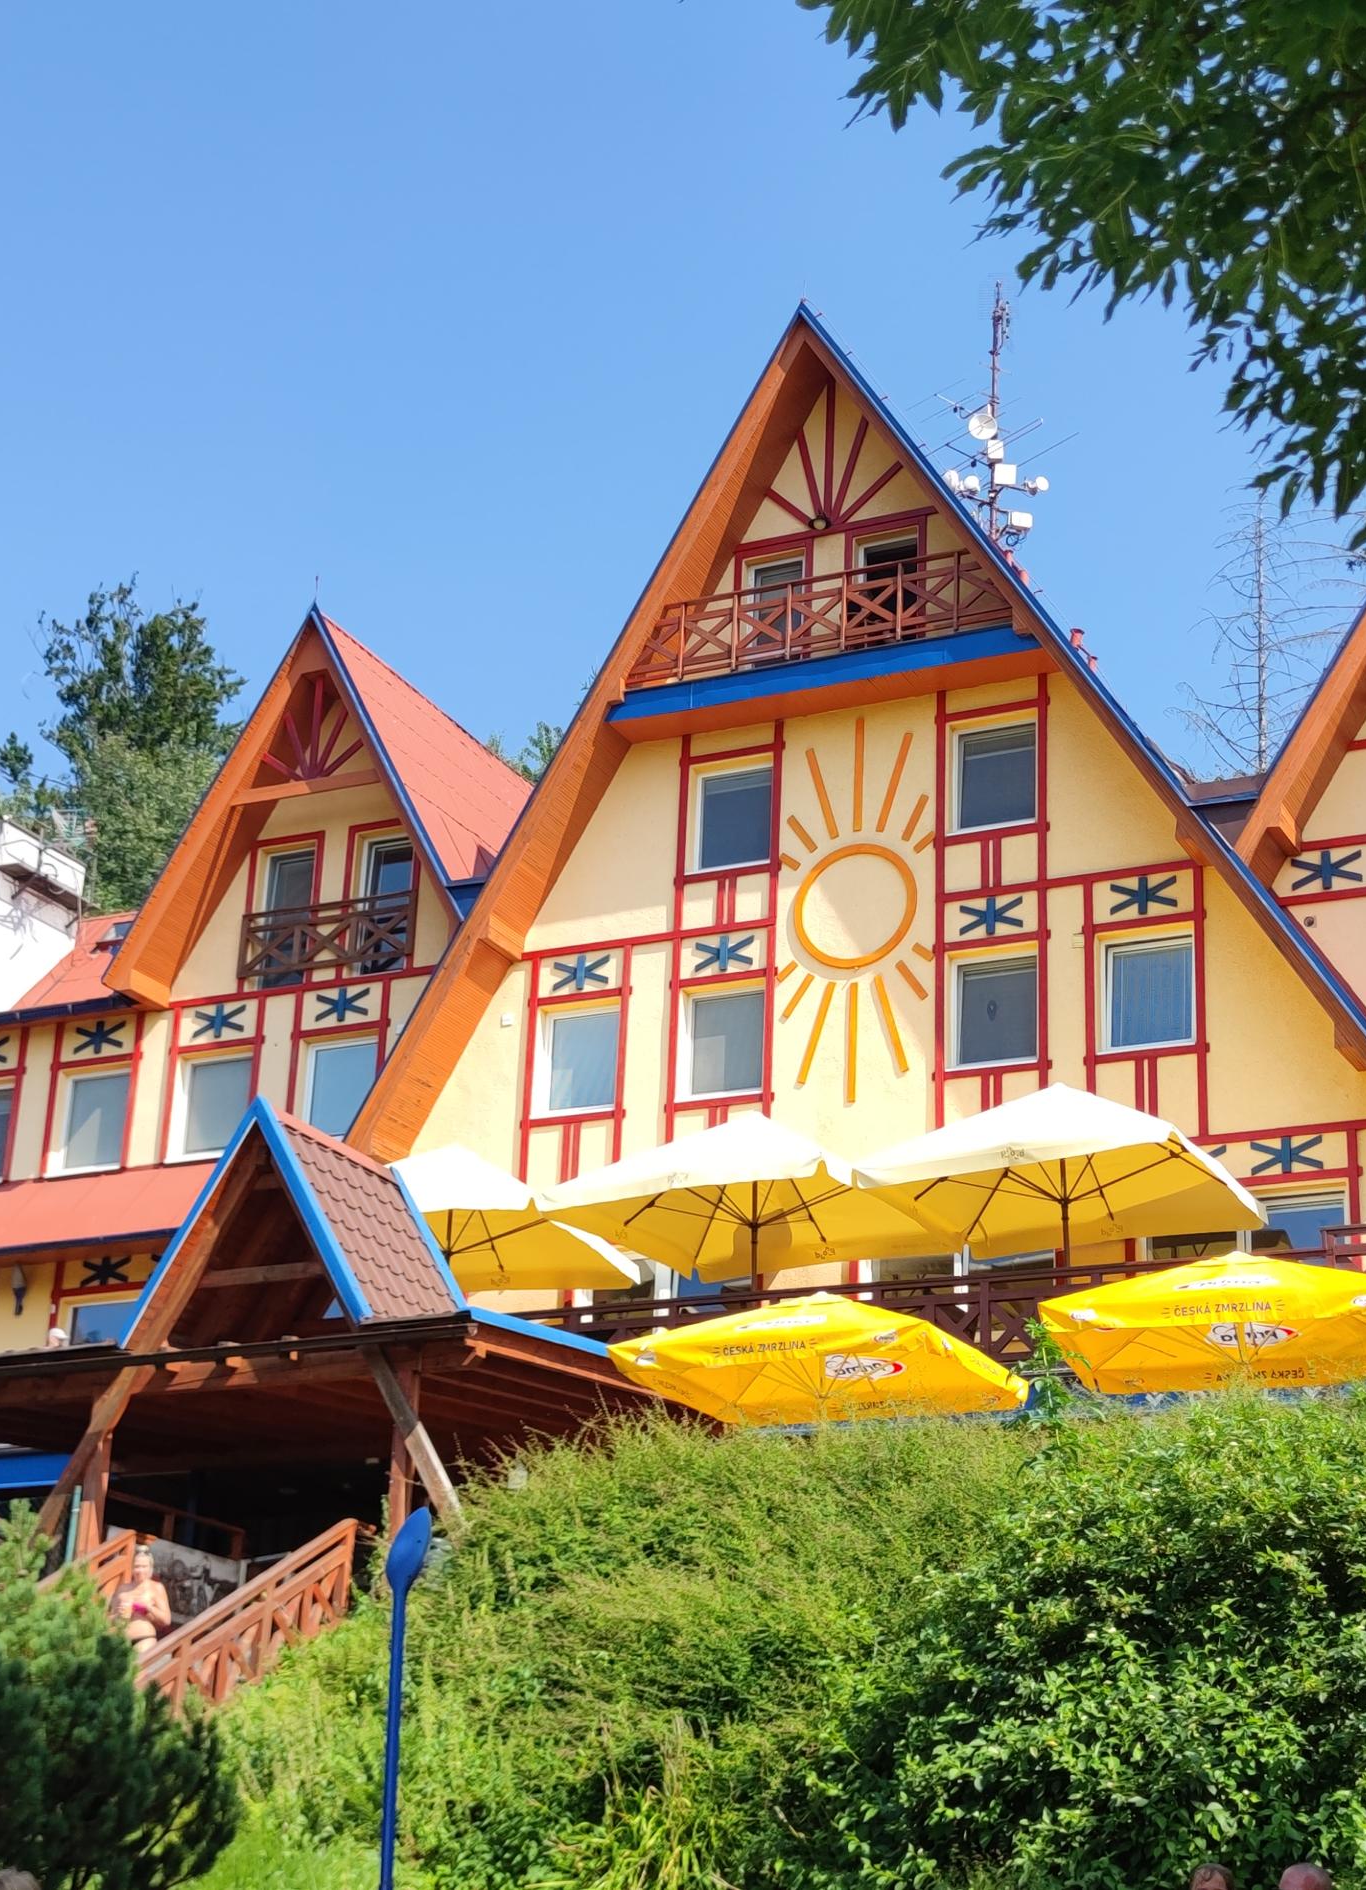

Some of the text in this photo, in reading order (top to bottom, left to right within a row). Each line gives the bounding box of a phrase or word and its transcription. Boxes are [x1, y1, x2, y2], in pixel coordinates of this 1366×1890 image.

[1174, 1301, 1272, 1317] ČESKÁ ZMRZLINA
[722, 1340, 807, 1357] ČESKÁ ZMRZLINA
